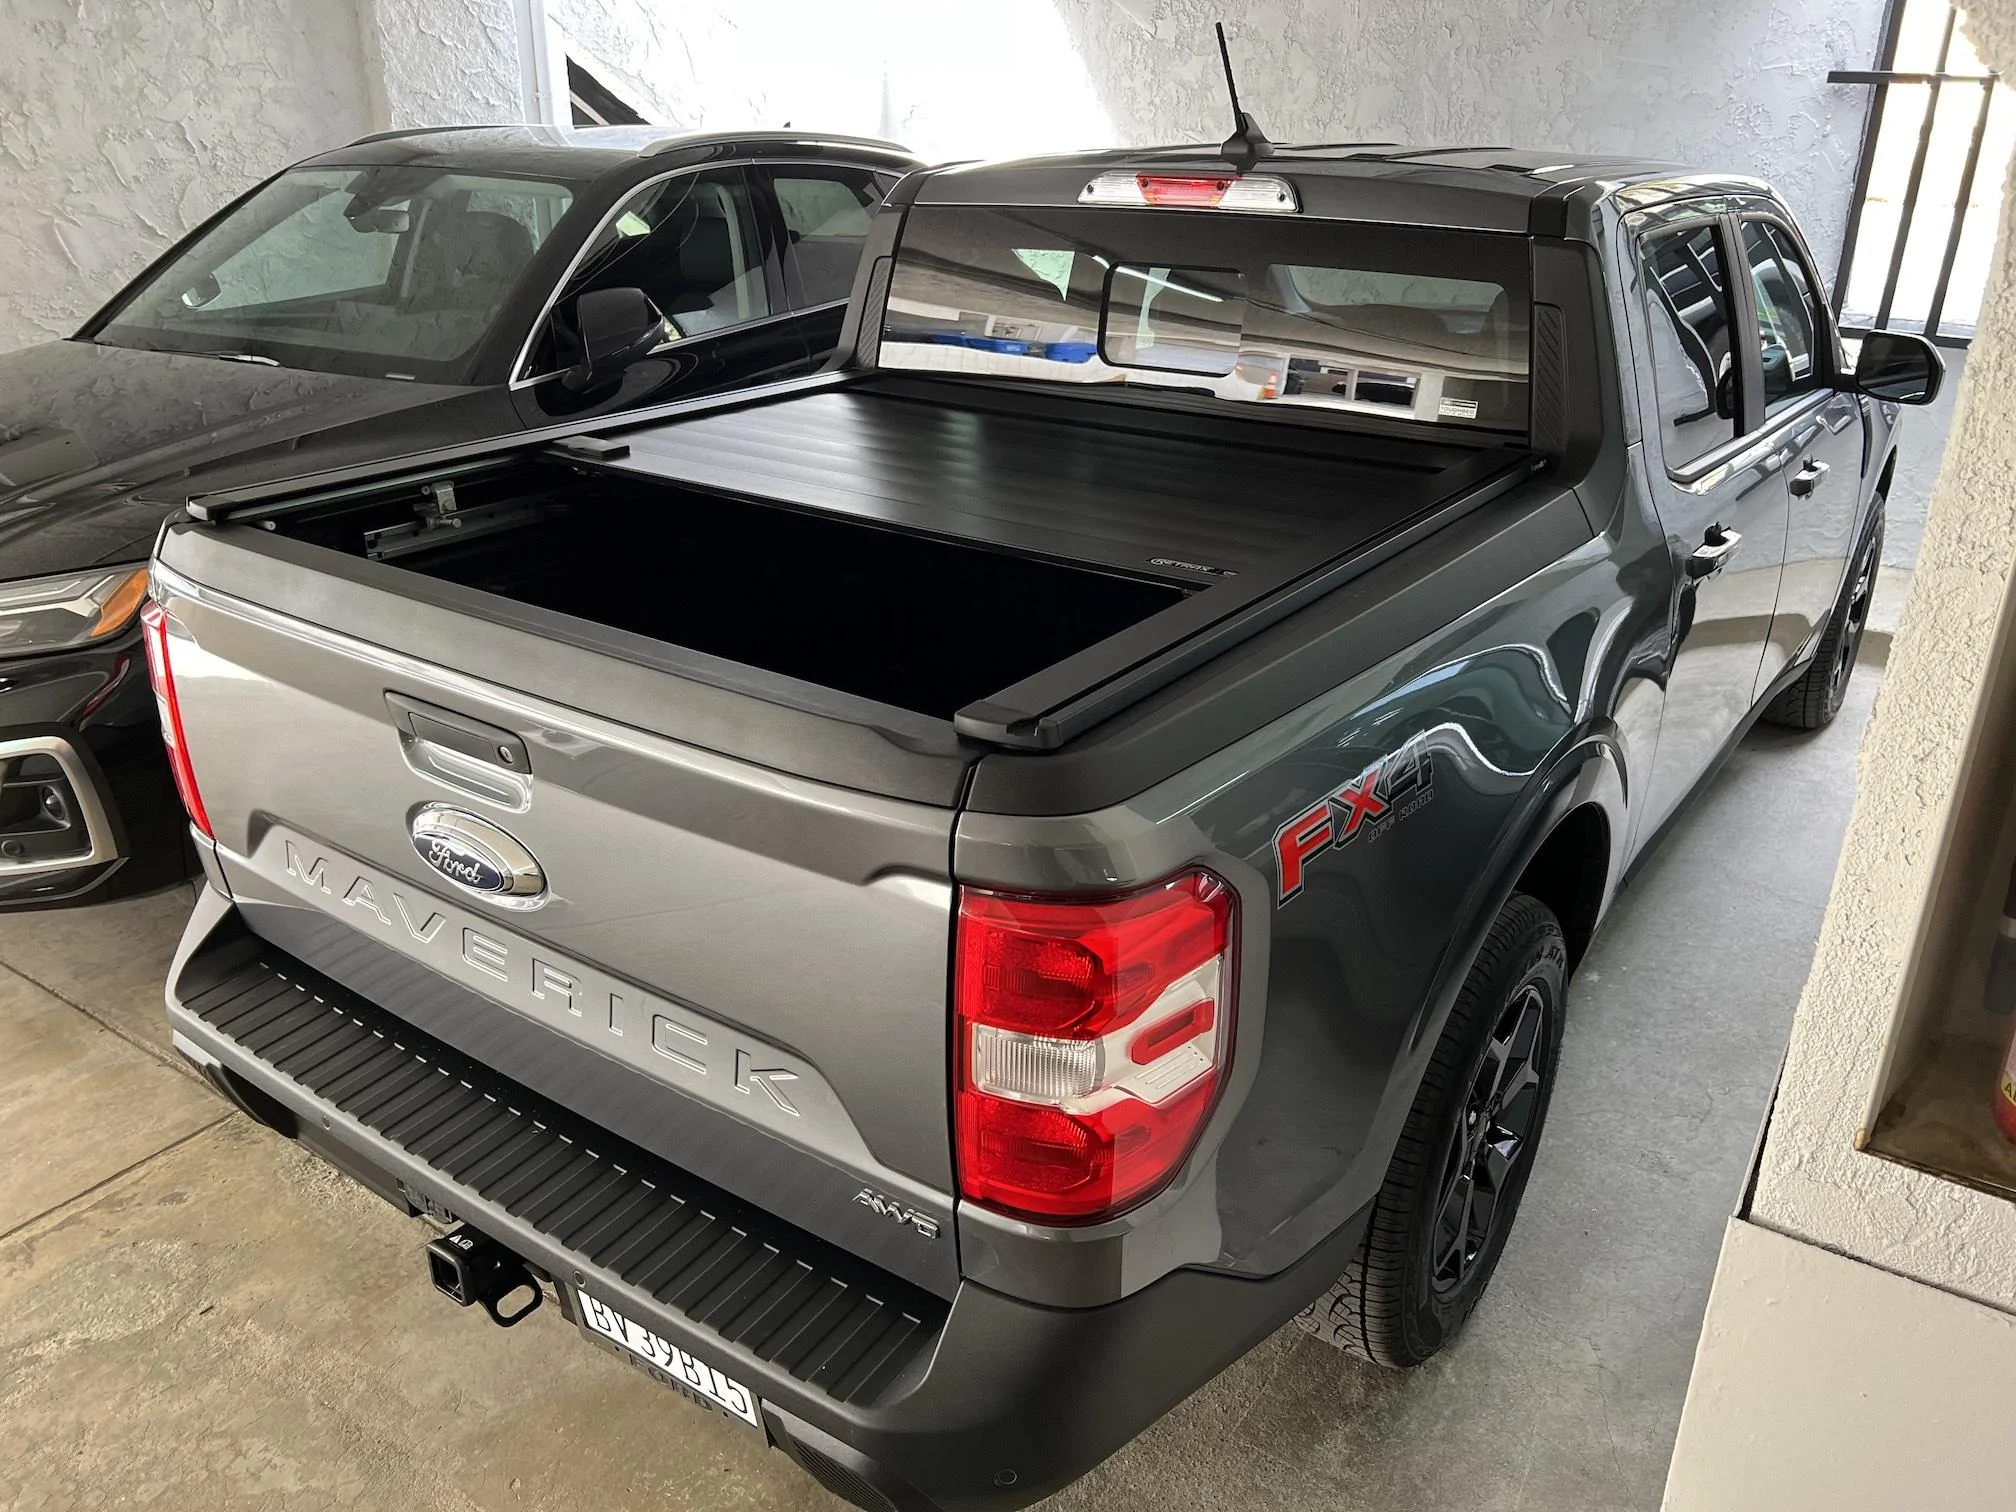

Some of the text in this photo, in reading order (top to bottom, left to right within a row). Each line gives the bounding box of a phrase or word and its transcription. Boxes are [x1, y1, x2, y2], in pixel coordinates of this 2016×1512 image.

[1272, 729, 1434, 911] FX4
[428, 839, 483, 884] Ford
[285, 839, 801, 1116] MAVERICK
[852, 1187, 940, 1239] AWD
[629, 1352, 713, 1412] FORD
